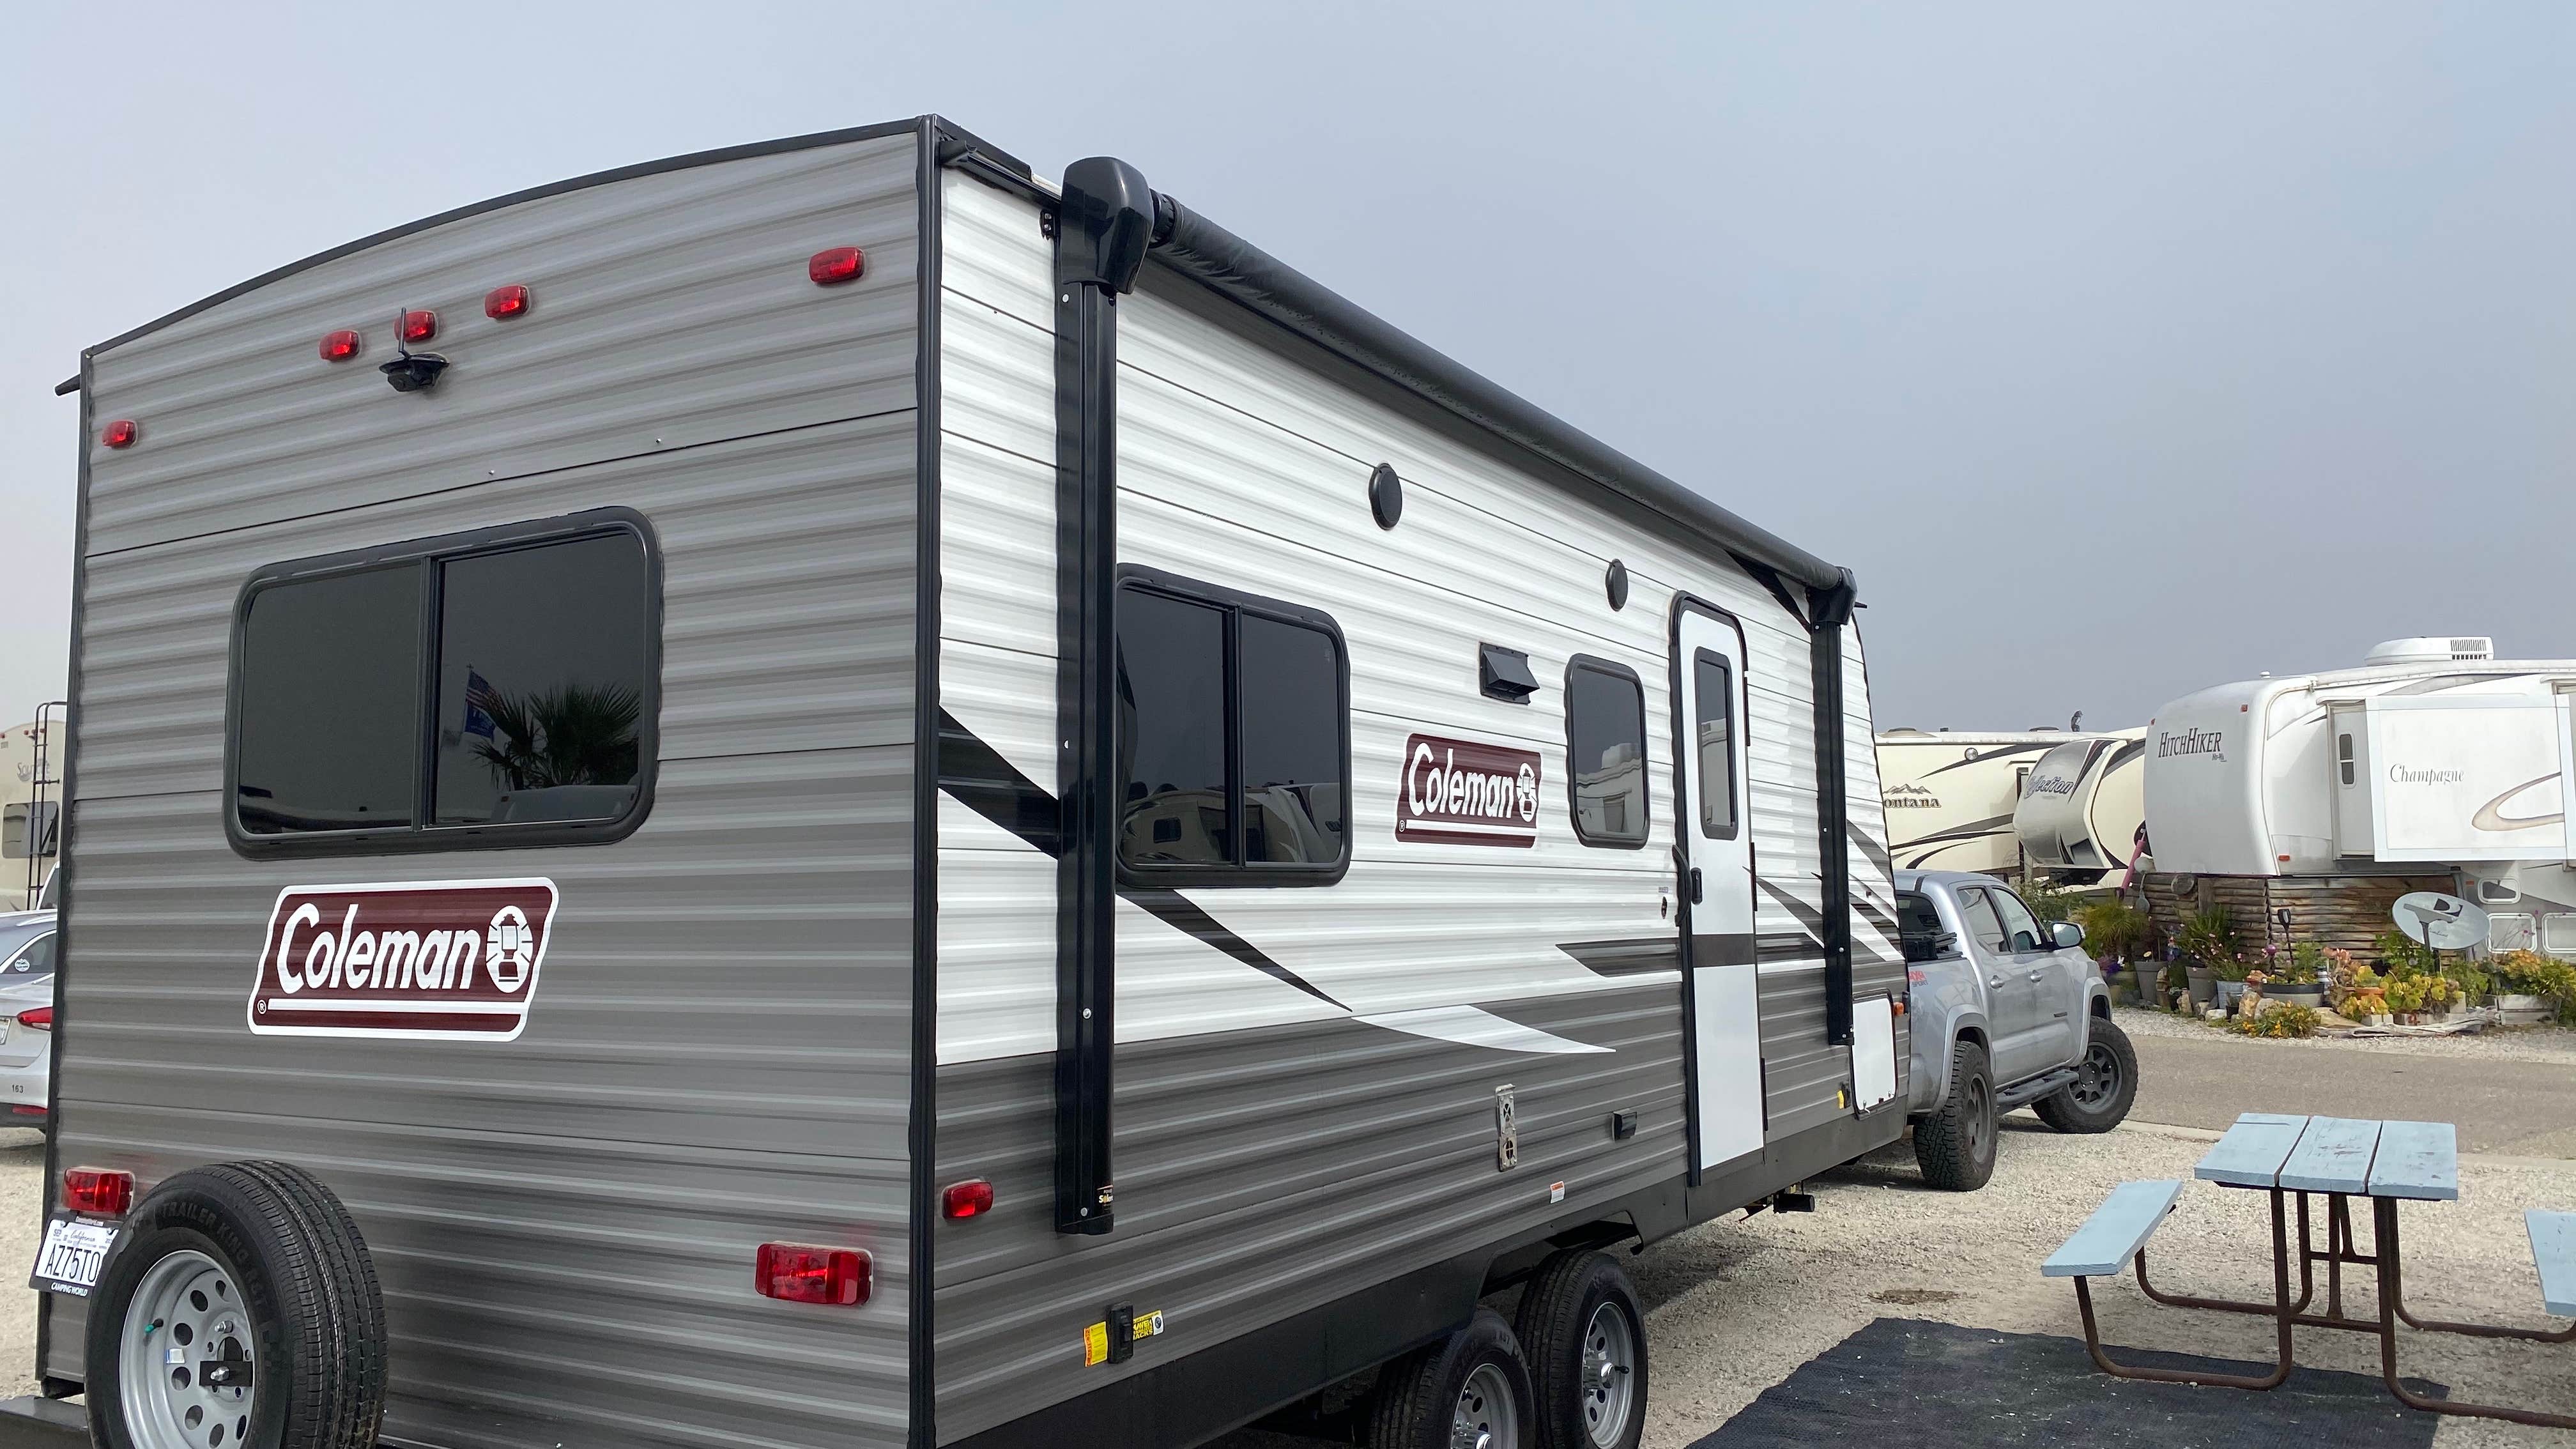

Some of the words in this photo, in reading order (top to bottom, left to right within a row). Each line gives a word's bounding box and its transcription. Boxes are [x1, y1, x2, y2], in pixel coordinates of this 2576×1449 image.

[1408, 742, 1514, 818] Coleman
[2390, 763, 2464, 786] Champagne
[1883, 797, 1942, 808] ontana
[277, 902, 480, 993] Coleman
[12, 1084, 24, 1093] 163
[70, 1230, 95, 1246] California
[51, 1282, 72, 1294] CAMPING
[71, 1286, 88, 1297] WORLD
